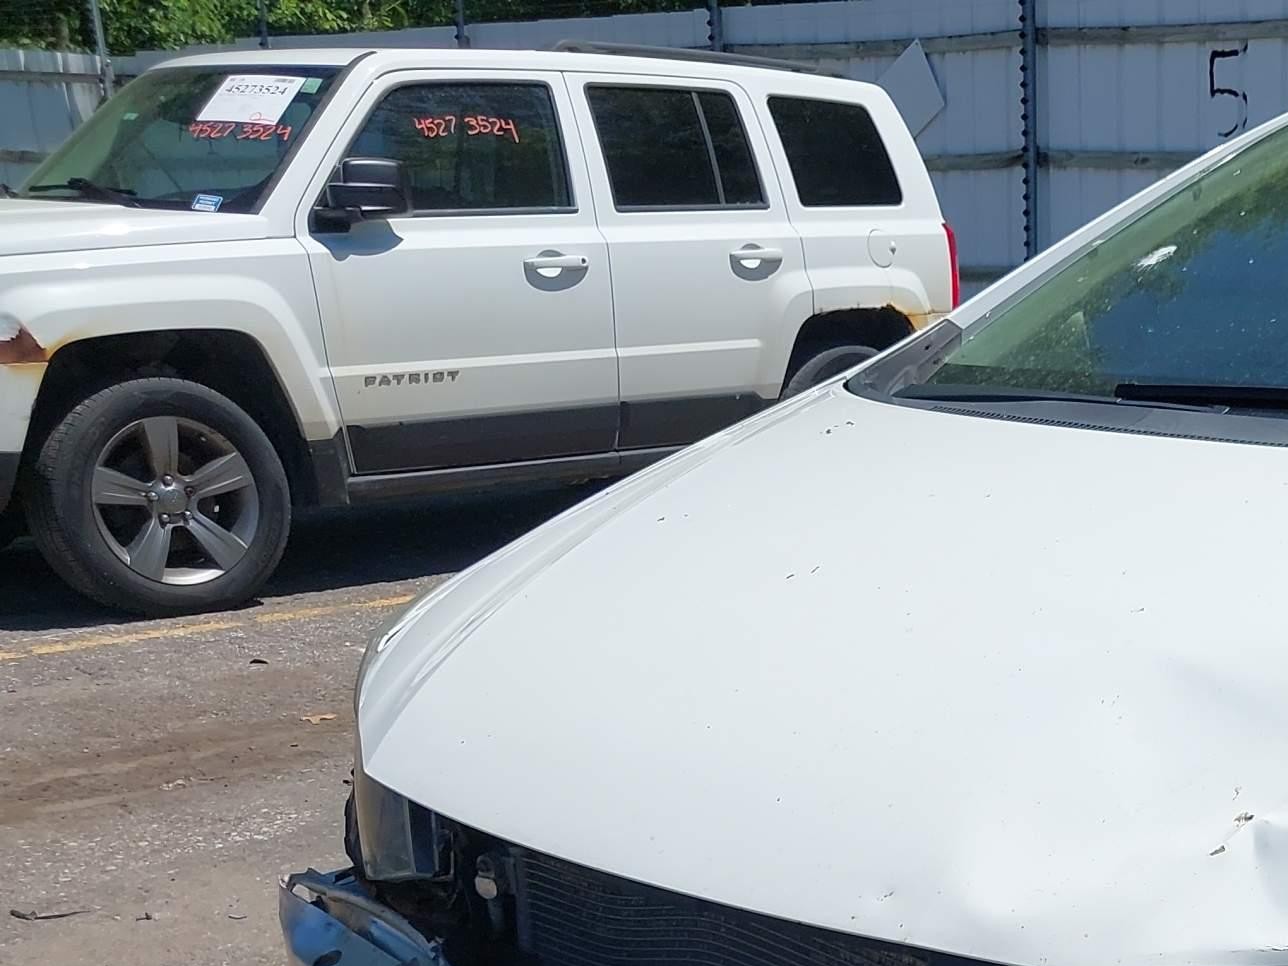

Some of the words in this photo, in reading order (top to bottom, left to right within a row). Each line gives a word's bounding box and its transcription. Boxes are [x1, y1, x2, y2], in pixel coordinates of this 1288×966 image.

[225, 84, 288, 95] 45273524
[1209, 43, 1248, 138] 5
[189, 122, 236, 138] 4527
[236, 123, 292, 140] 3524
[413, 115, 456, 137] 4527
[464, 115, 520, 143] 3524
[364, 370, 460, 387] PATRIOT
